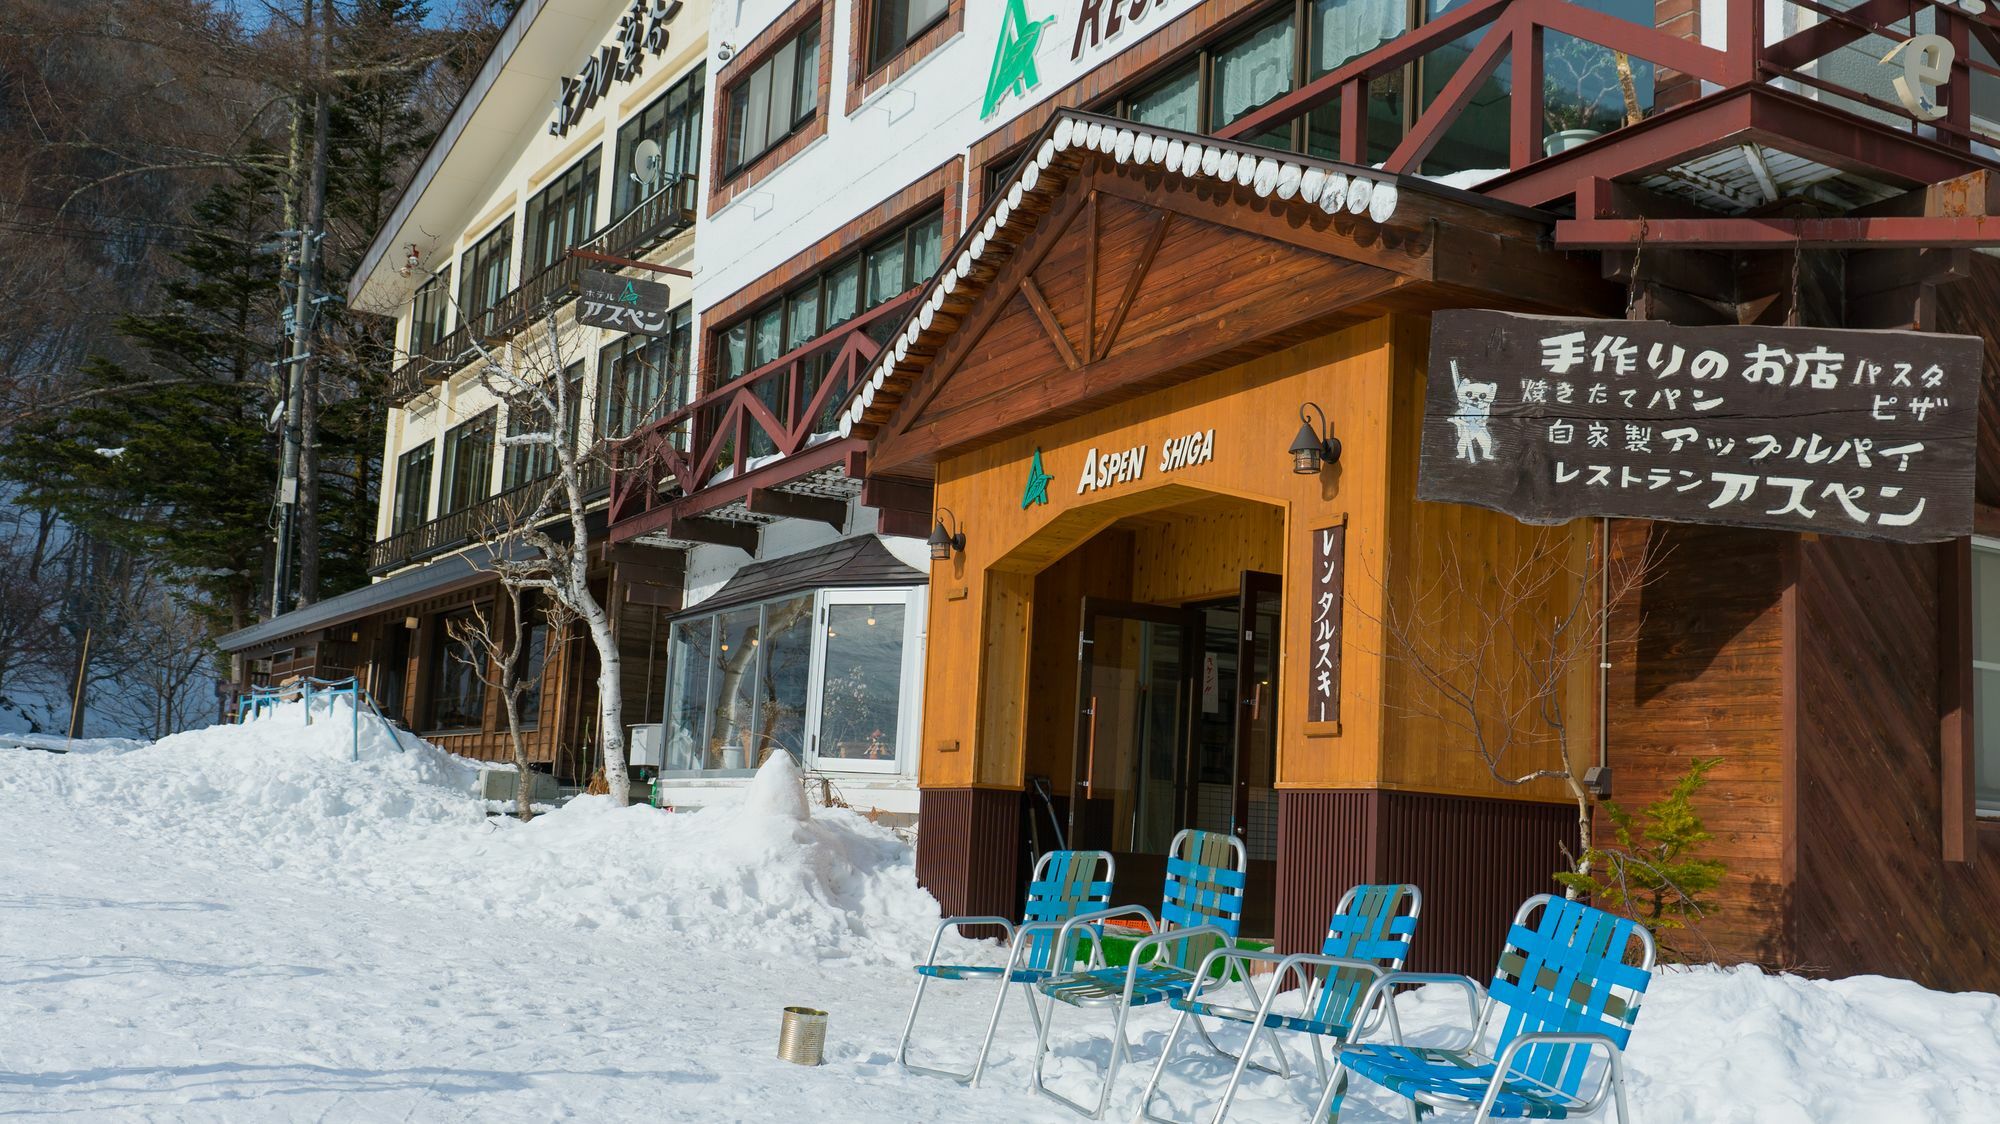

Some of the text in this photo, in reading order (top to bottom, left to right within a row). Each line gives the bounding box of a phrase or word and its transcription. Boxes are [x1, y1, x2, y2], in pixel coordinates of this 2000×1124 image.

[585, 290, 615, 301] ホテル
[581, 300, 665, 331] アスペン
[1540, 330, 1845, 389] 手作りのお店
[1852, 359, 1944, 388] パスタ
[1522, 379, 1724, 412] 焼きたてパン
[1872, 394, 1949, 422] ピザ
[1160, 430, 1214, 472] SHIGA
[1548, 419, 1925, 472] 自家製アップルパイ
[1314, 530, 1336, 722] レンタルスキー
